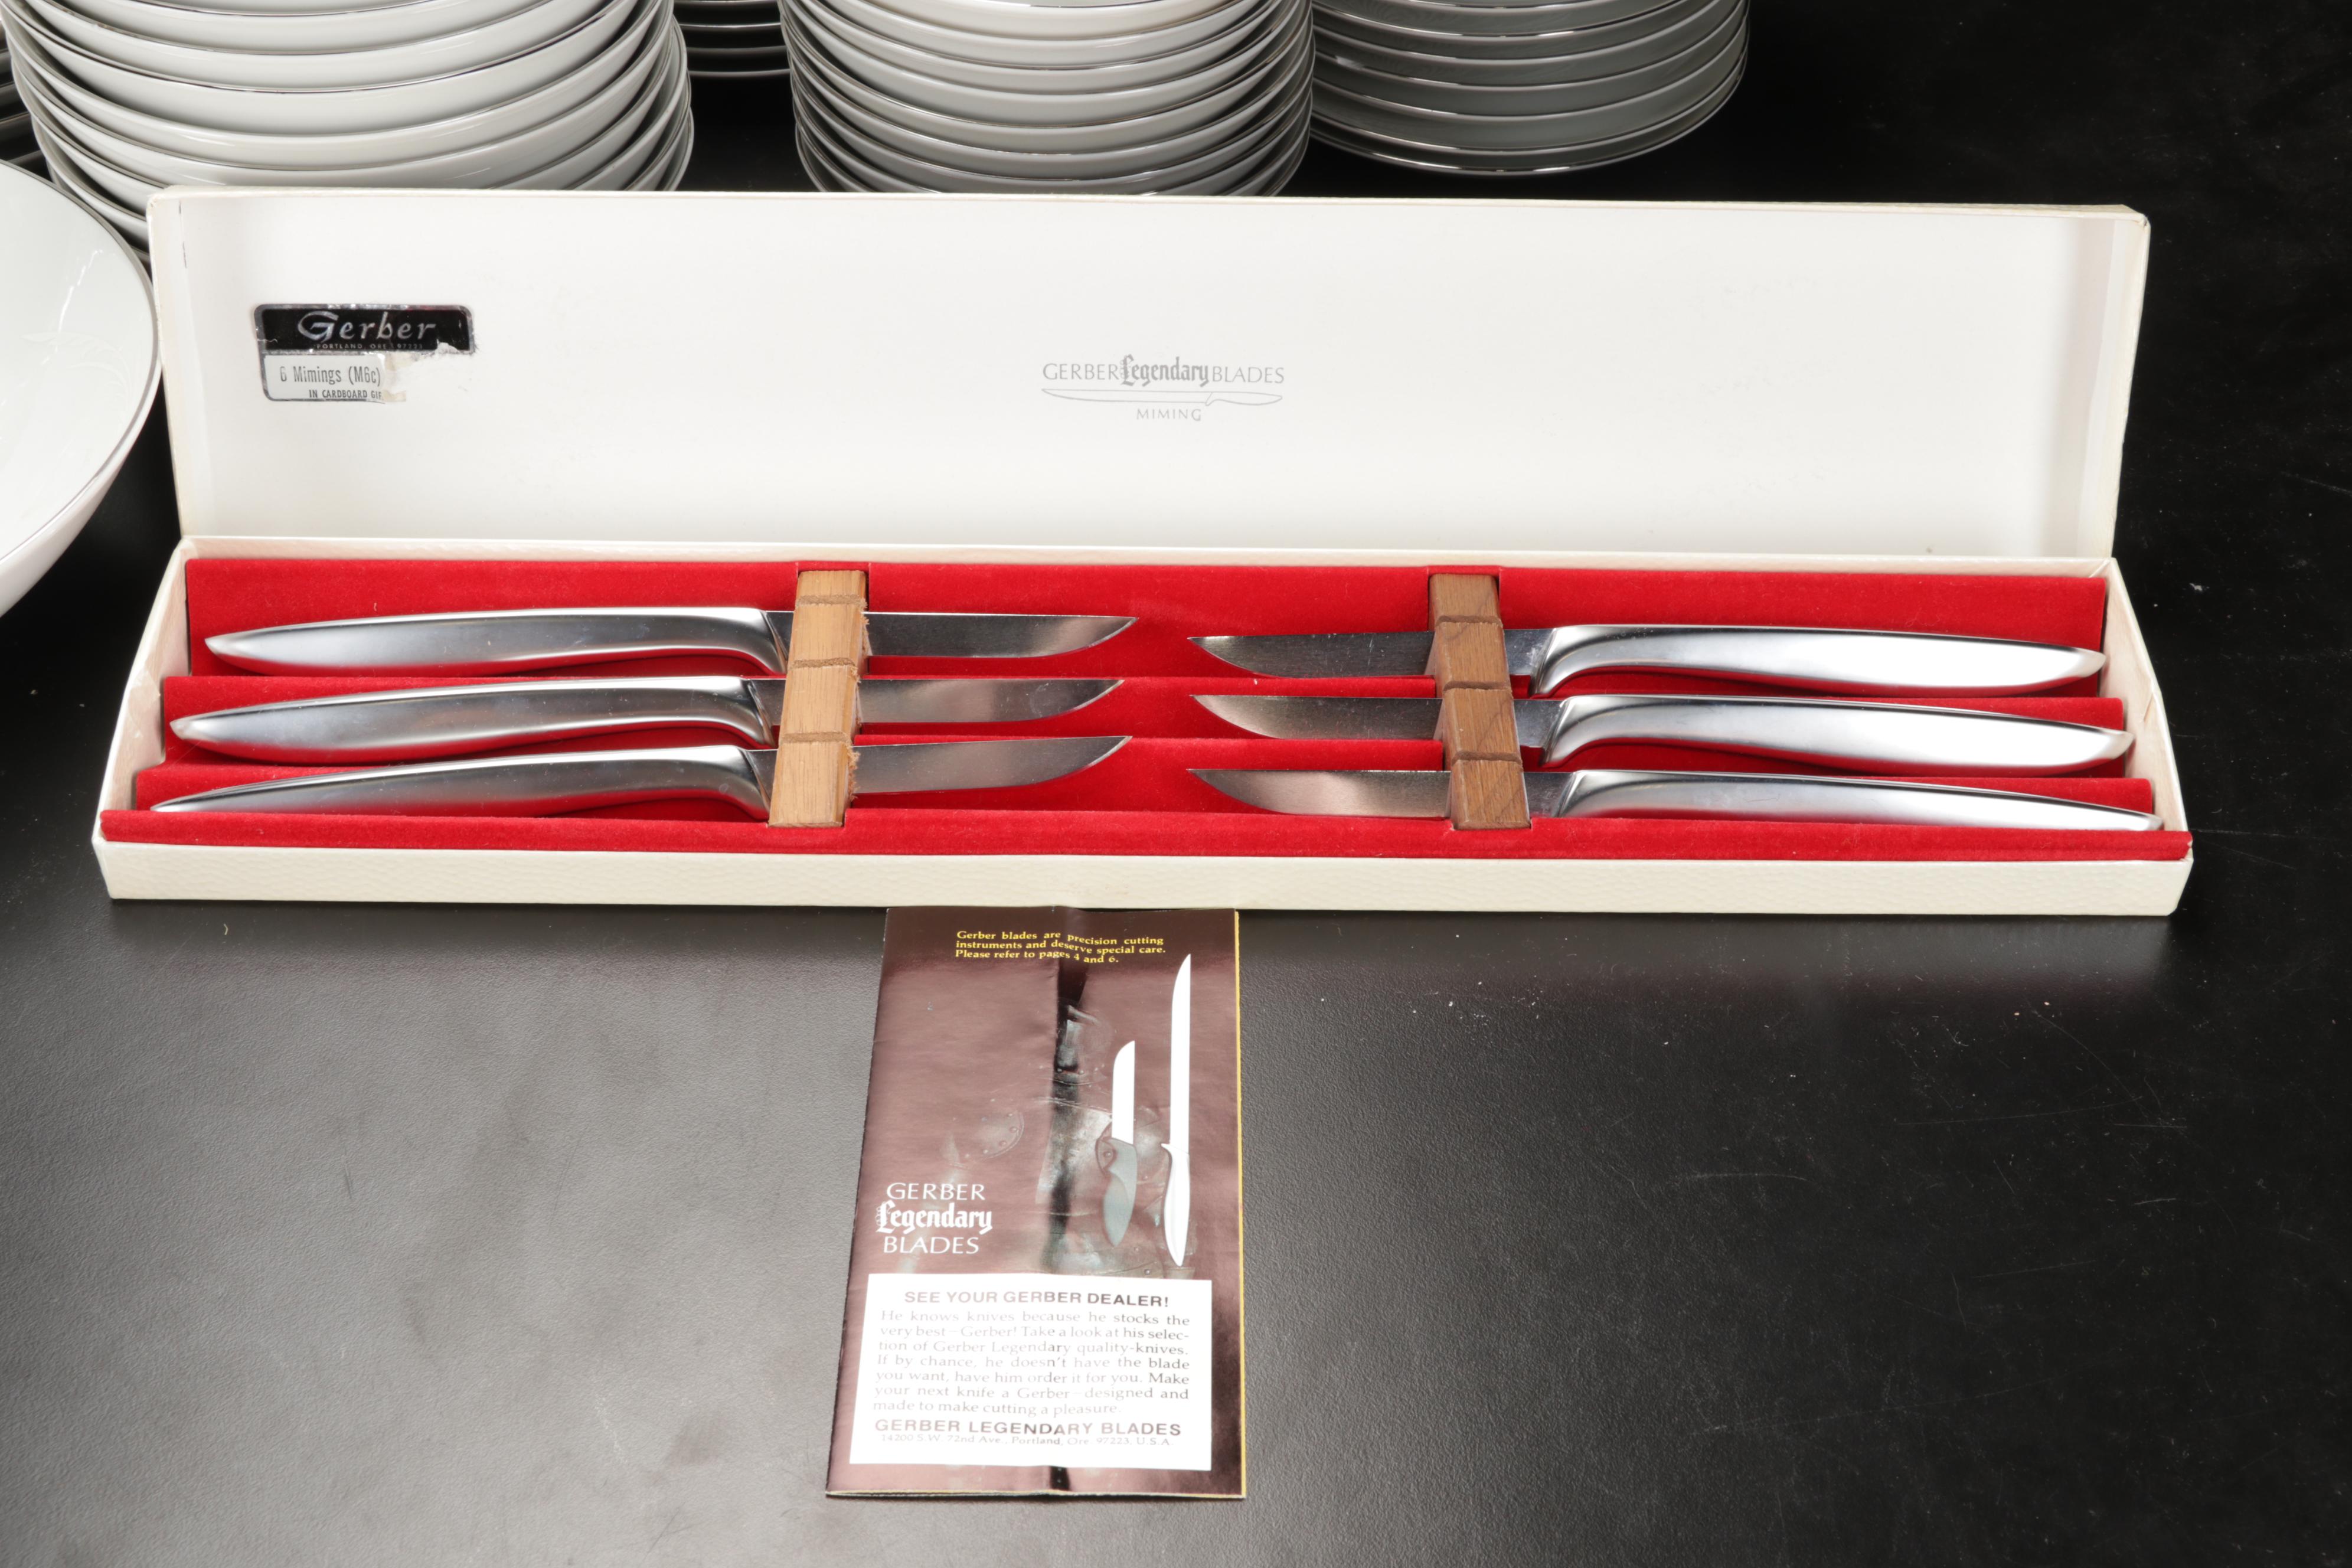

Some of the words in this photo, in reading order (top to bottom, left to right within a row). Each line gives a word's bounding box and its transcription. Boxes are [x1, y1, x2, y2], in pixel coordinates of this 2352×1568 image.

[298, 311, 436, 342] Gerber
[280, 366, 287, 382] 6
[293, 366, 342, 385] Mimings
[348, 366, 381, 387] (M6c)
[1043, 363, 1119, 380] GERBER
[1119, 354, 1210, 387] Legendary
[1212, 366, 1284, 384] BLADES
[309, 390, 318, 398] IN
[322, 390, 367, 398] CARDBOARD
[1136, 409, 1201, 422] MIMING
[956, 931, 996, 939] Gerber
[1067, 933, 1118, 945] precision
[1124, 937, 1164, 946] cutting
[956, 941, 1023, 949] instruments
[1051, 940, 1092, 954] deserve
[1096, 946, 1135, 955] special
[1039, 950, 1070, 959] pages
[1083, 955, 1104, 963] and
[887, 1182, 985, 1200] GERBER
[875, 1200, 993, 1235] Legendary
[883, 1236, 979, 1254] BLADES
[904, 1292, 940, 1303] SEE
[946, 1292, 997, 1303] YOUR
[1004, 1291, 1081, 1303] GERBER
[1087, 1293, 1168, 1307] DEALER!
[881, 1310, 903, 1321] He
[910, 1311, 959, 1321] knows
[967, 1311, 1014, 1322] knives
[1022, 1311, 1080, 1322] because
[1089, 1312, 1106, 1322] he
[1113, 1313, 1159, 1324] stocks
[1167, 1315, 1190, 1325] the
[880, 1327, 912, 1339] very
[1021, 1326, 1055, 1337] Take
[1071, 1327, 1102, 1337] look
[1106, 1328, 1119, 1337] at
[1124, 1327, 1144, 1338] his
[1148, 1328, 1188, 1340] selec-
[879, 1341, 907, 1350] tion
[913, 1341, 929, 1351] of
[933, 1341, 985, 1352] Gerber
[992, 1341, 1071, 1356] Legendary
[1077, 1342, 1188, 1355] quality-knives.
[878, 1354, 888, 1364] If
[896, 1355, 913, 1368] by
[920, 1355, 977, 1368] chance,
[985, 1357, 1003, 1367] he
[1074, 1357, 1110, 1367] have
[1118, 1357, 1142, 1367] the
[1149, 1358, 1190, 1369] blade
[876, 1373, 903, 1383] you
[909, 1373, 949, 1382] want,
[955, 1371, 989, 1382] have
[995, 1372, 1023, 1383] him
[1028, 1373, 1067, 1383] order
[1072, 1373, 1080, 1383] it
[1086, 1373, 1106, 1383] for
[1111, 1374, 1142, 1386] you.
[1148, 1373, 1190, 1384] Make
[874, 1387, 910, 1397] your
[917, 1386, 949, 1396] next
[957, 1386, 995, 1397] knife
[1161, 1389, 1188, 1399] and
[873, 1400, 914, 1410] made
[919, 1401, 934, 1410] to
[938, 1402, 979, 1413] make
[983, 1403, 1037, 1417] cutting
[875, 1419, 961, 1432] GERBER
[969, 1421, 1093, 1435] LEGENDARY
[1101, 1422, 1181, 1436] BLADES
